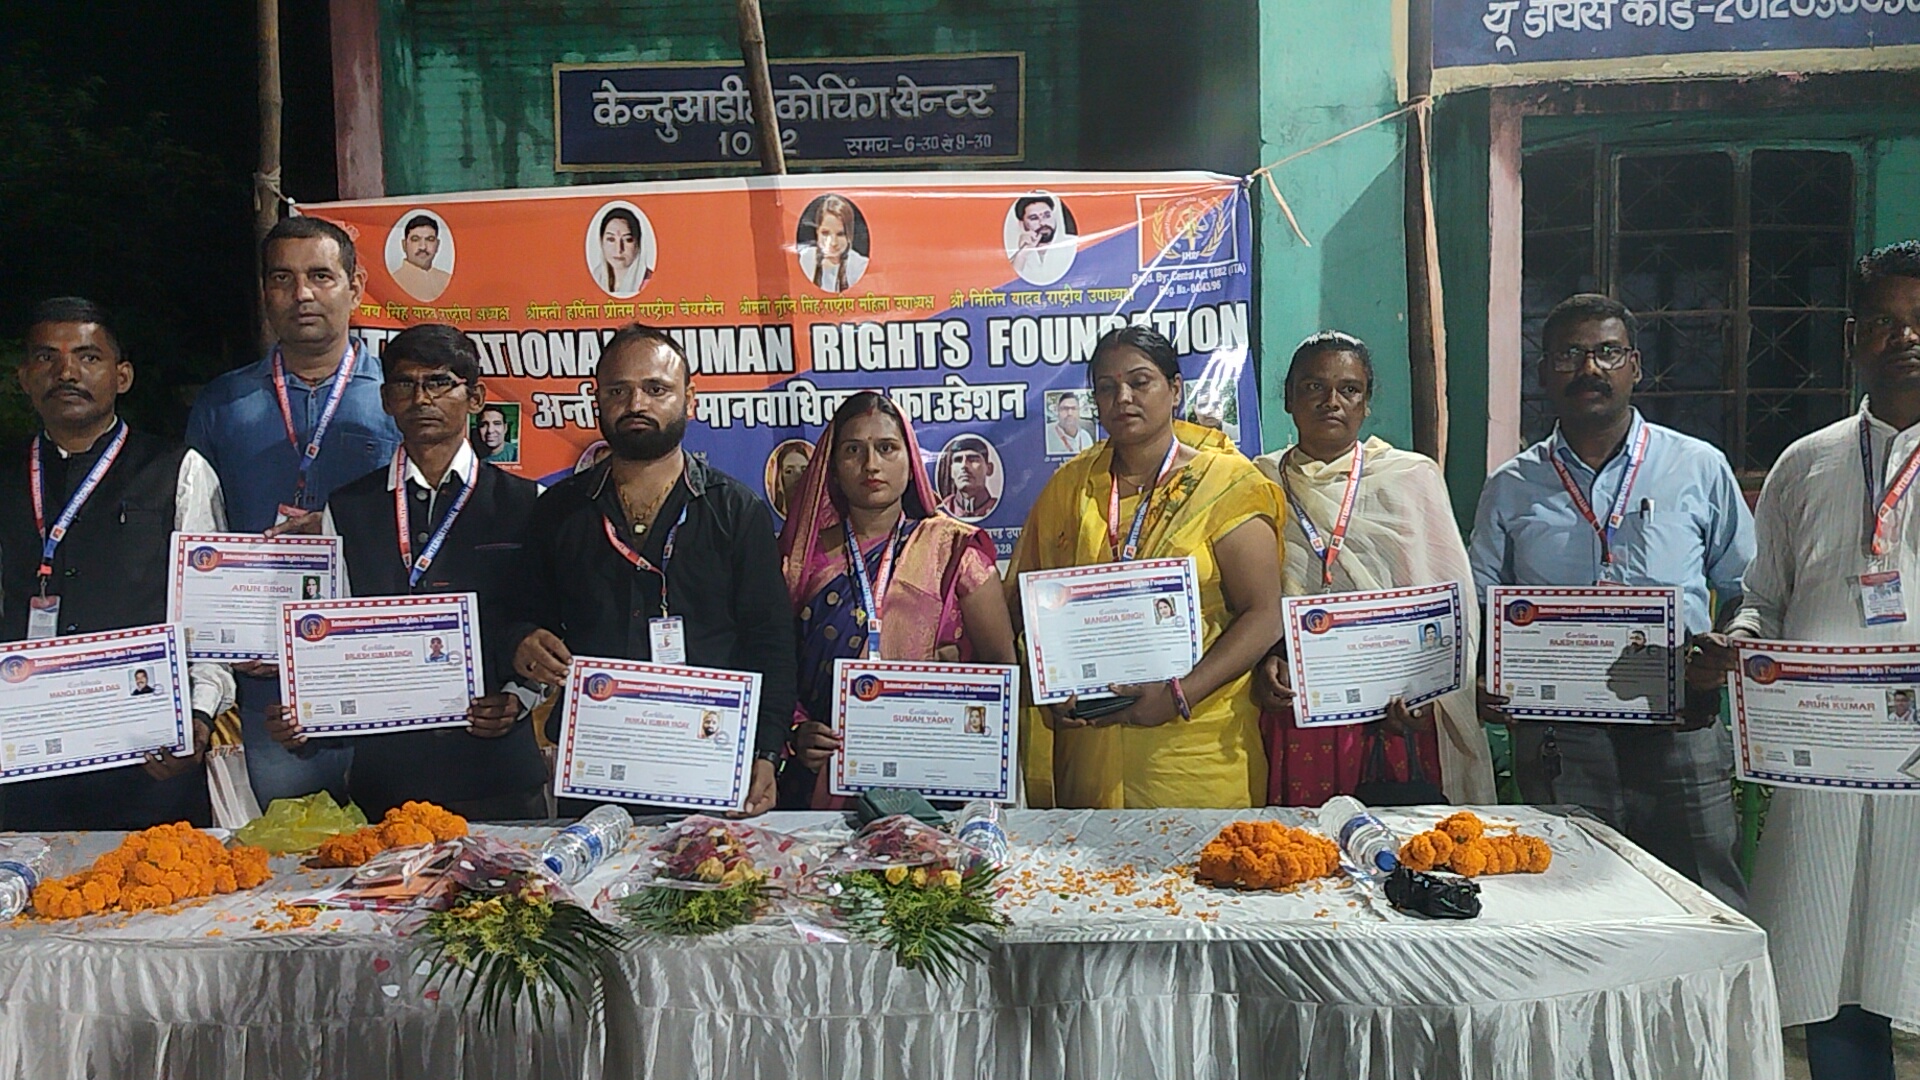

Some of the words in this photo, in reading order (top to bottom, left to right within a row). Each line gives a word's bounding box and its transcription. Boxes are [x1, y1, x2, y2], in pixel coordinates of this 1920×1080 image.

[655, 325, 795, 374] UMAN
[811, 320, 972, 371] RIGHTS
[988, 303, 1249, 366] FOUNTION
[1885, 664, 1920, 674] Foundati
